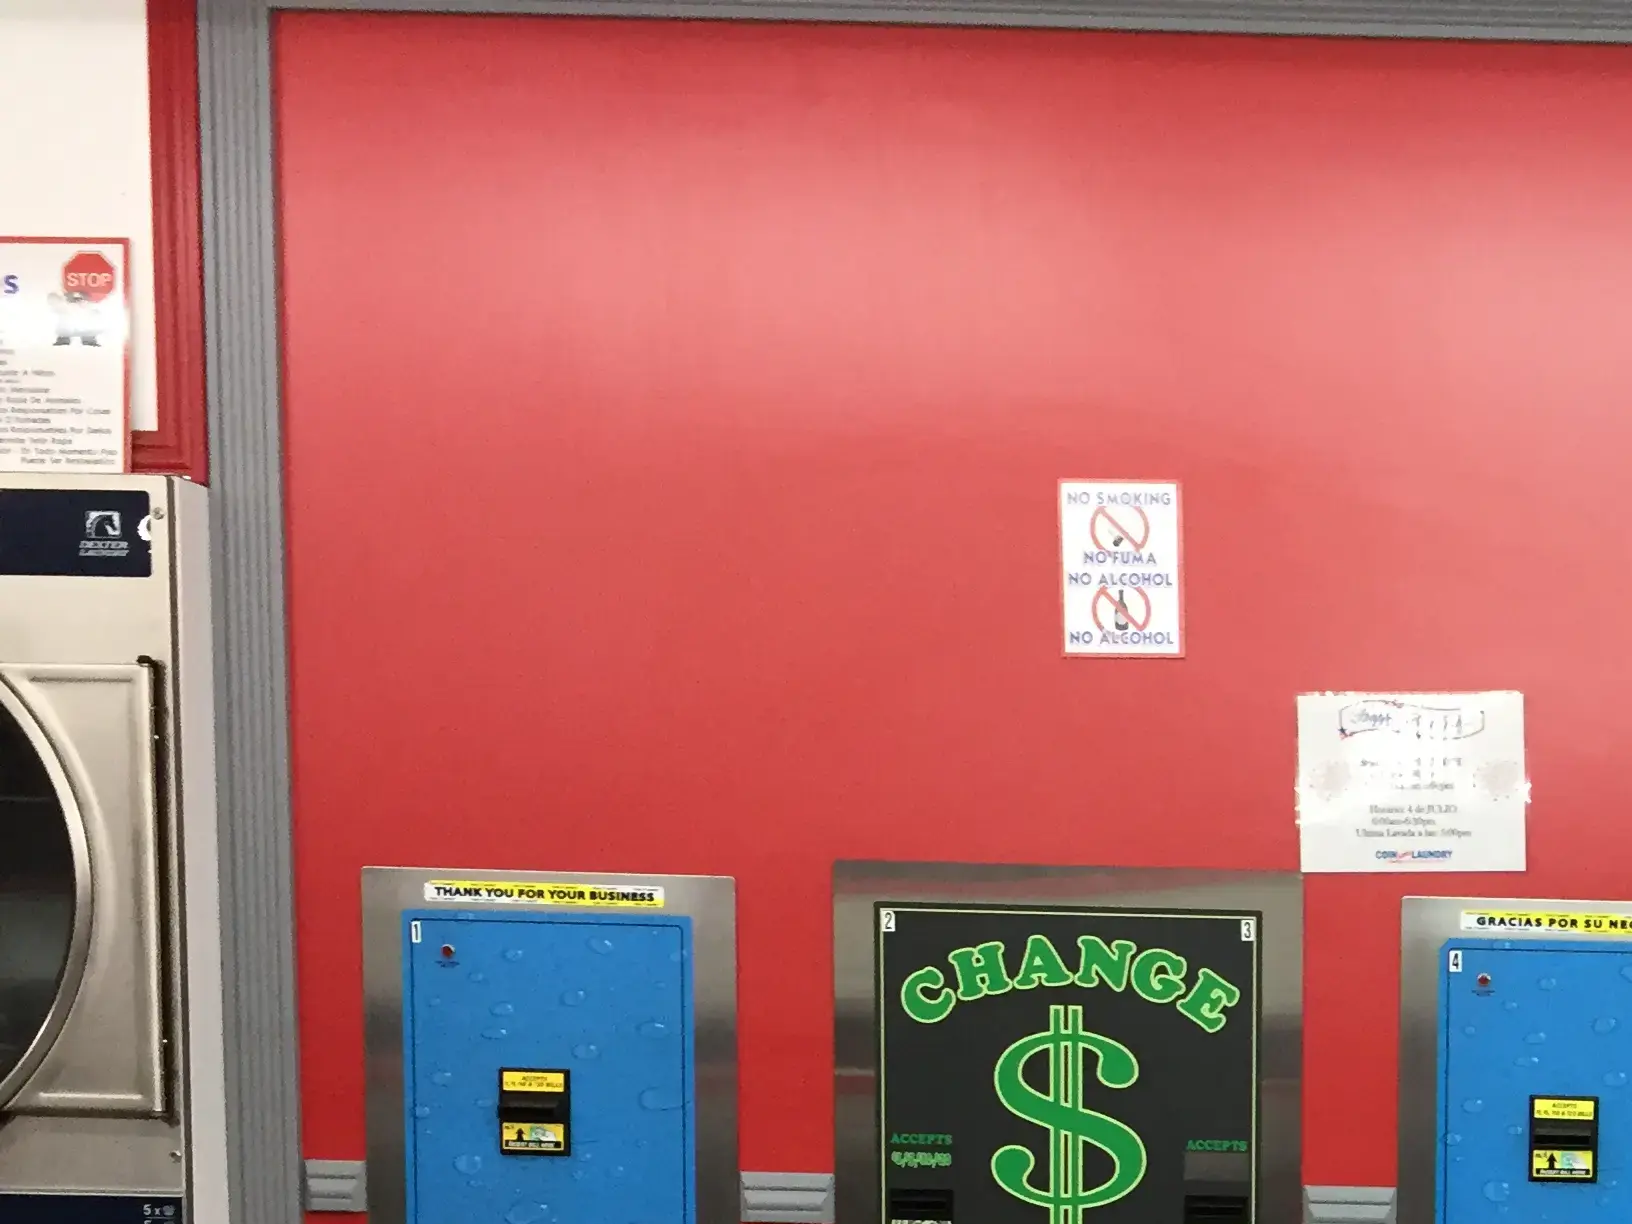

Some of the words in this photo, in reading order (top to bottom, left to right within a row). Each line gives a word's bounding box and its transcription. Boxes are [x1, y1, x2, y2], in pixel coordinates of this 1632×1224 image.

[66, 272, 112, 287] STOP
[1067, 491, 1091, 505] NO
[1096, 491, 1171, 506] SMOKING
[1083, 551, 1107, 564] NO
[1112, 551, 1157, 565] FUMA
[1069, 572, 1092, 585] NO
[1098, 572, 1173, 586] ALCOHOL
[1070, 631, 1093, 644] NO
[1099, 631, 1174, 645] ALCOHOL
[1411, 850, 1453, 859] LAUNDRY
[434, 886, 481, 897] THANK
[484, 887, 514, 898] YOU
[517, 888, 545, 899] FOR
[548, 889, 586, 900] YOUR
[589, 890, 655, 902] BUSINESS
[884, 912, 893, 930] 2
[1476, 916, 1543, 927] GRACIAS
[1548, 918, 1579, 929] POR
[1584, 918, 1603, 929] SU
[1243, 921, 1251, 938] 3
[1451, 953, 1460, 970] 4
[901, 934, 1241, 1034] CHANGE
[890, 1133, 953, 1145] ACCEPTS
[1186, 1139, 1248, 1152] ACCEPTS
[143, 1204, 152, 1216] 5
